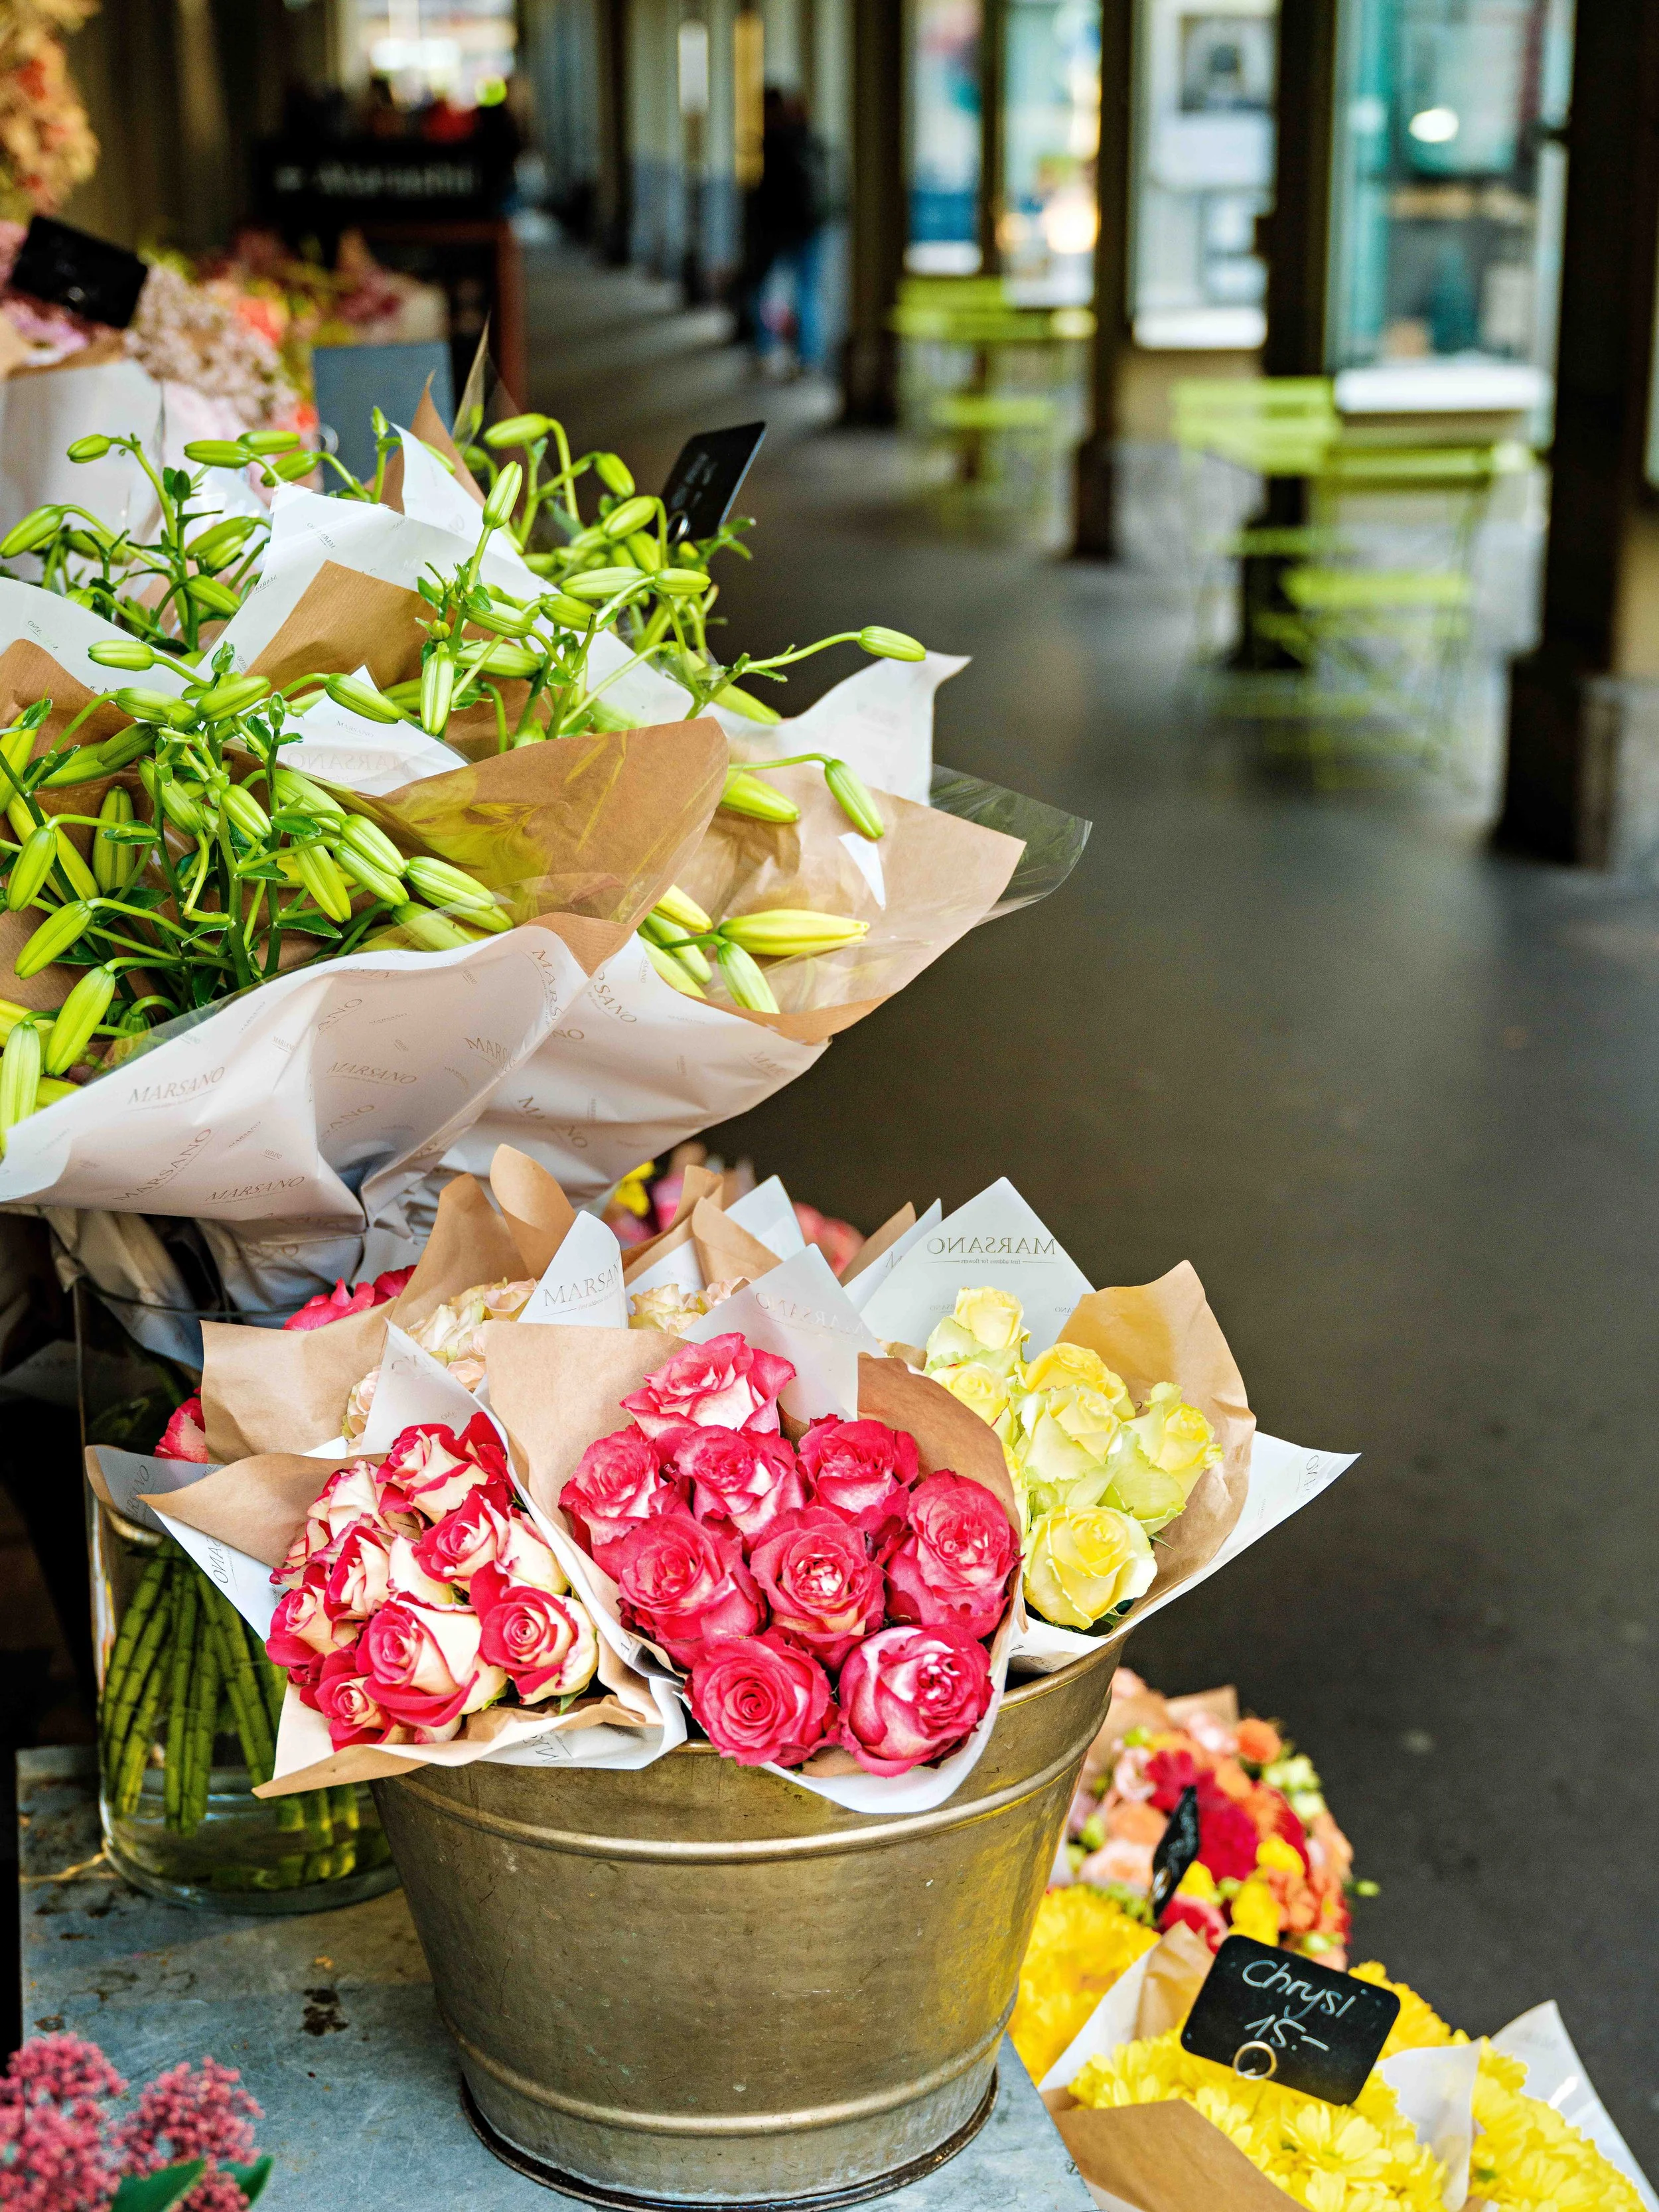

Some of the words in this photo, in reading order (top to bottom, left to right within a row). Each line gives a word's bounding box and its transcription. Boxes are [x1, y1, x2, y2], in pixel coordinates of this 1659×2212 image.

[127, 1067, 225, 1105] MARSANO
[327, 1062, 417, 1084] MARSANO
[112, 1129, 211, 1201] MARSANO
[205, 1176, 305, 1201] MARSANO
